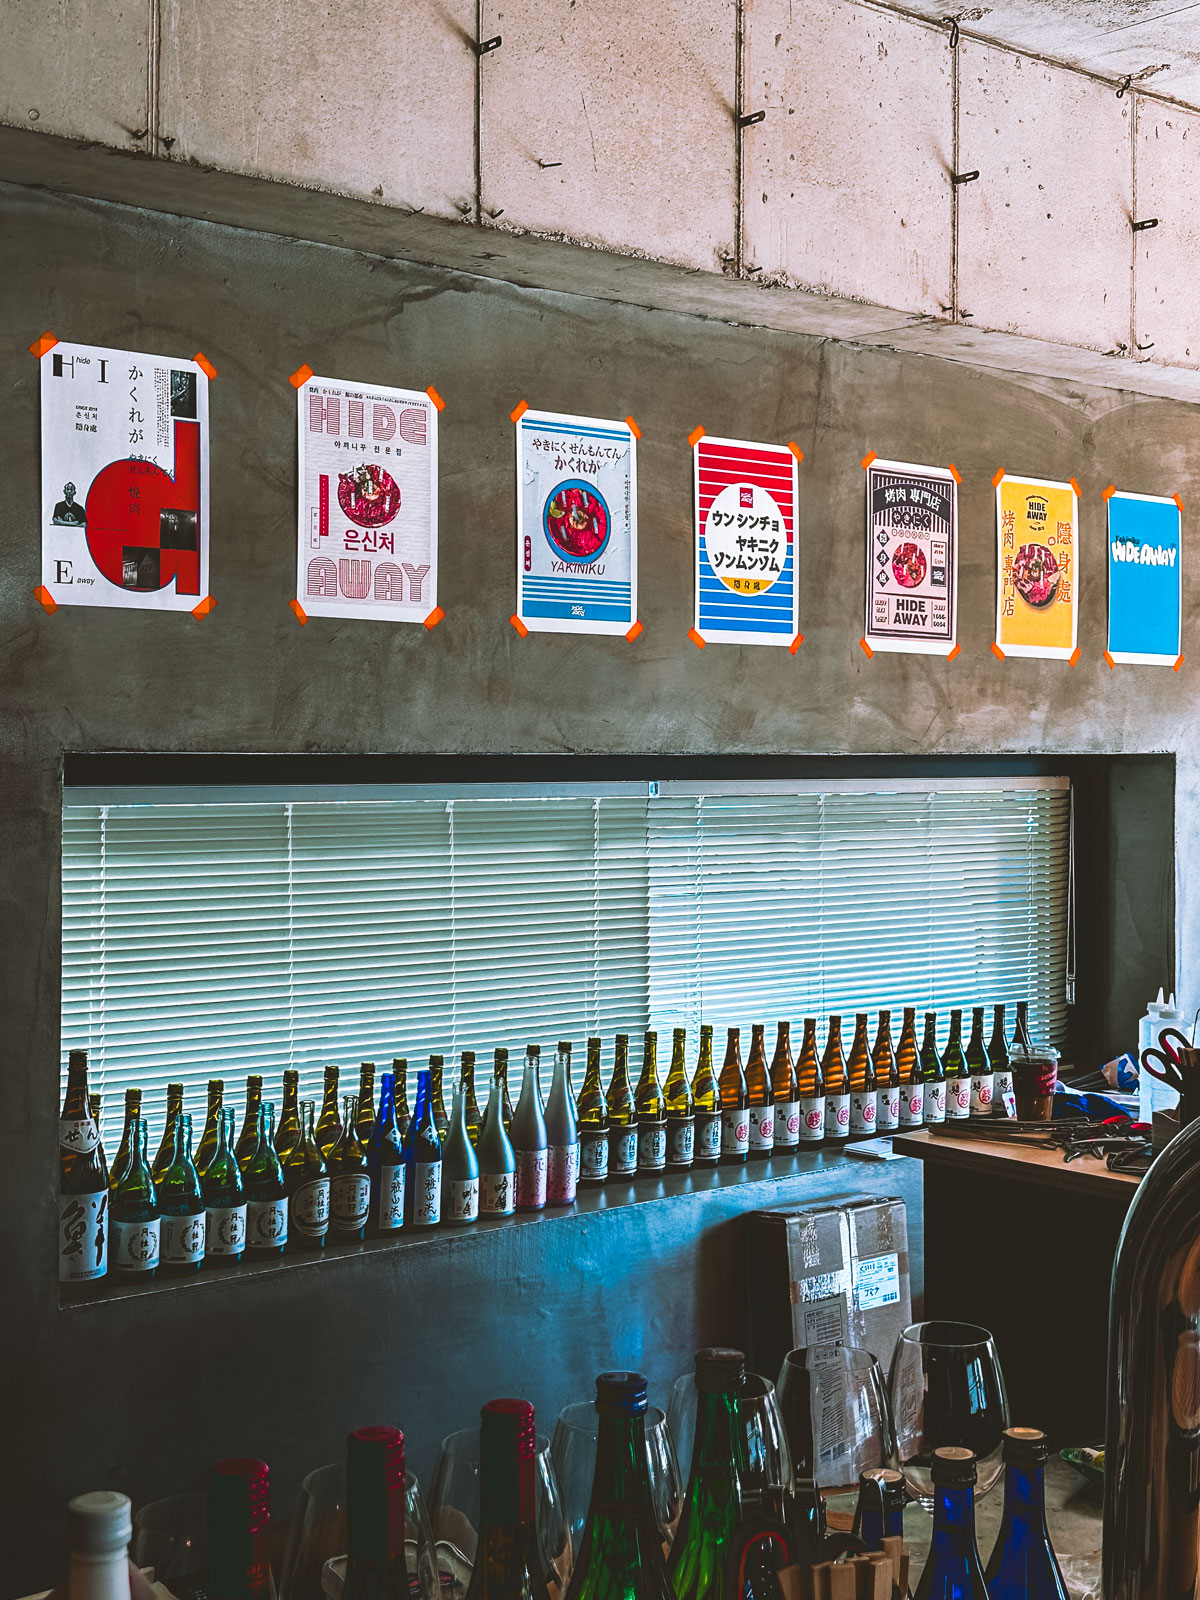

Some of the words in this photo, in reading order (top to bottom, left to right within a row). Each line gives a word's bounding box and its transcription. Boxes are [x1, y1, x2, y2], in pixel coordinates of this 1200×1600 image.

[128, 365, 144, 444] かくれが
[310, 395, 427, 446] HIDE
[532, 438, 567, 454] やきにく
[569, 443, 622, 460] せんもんてん
[554, 455, 601, 475] かくれが
[1026, 510, 1047, 521] AWAY
[1028, 501, 1046, 512] HIDE
[343, 529, 395, 555] 은신처
[735, 535, 779, 554] ヤキニク
[551, 560, 606, 576] YAKINIKU
[307, 556, 431, 602] AWAY
[896, 598, 926, 613] HIDE
[893, 612, 928, 627] AWAY
